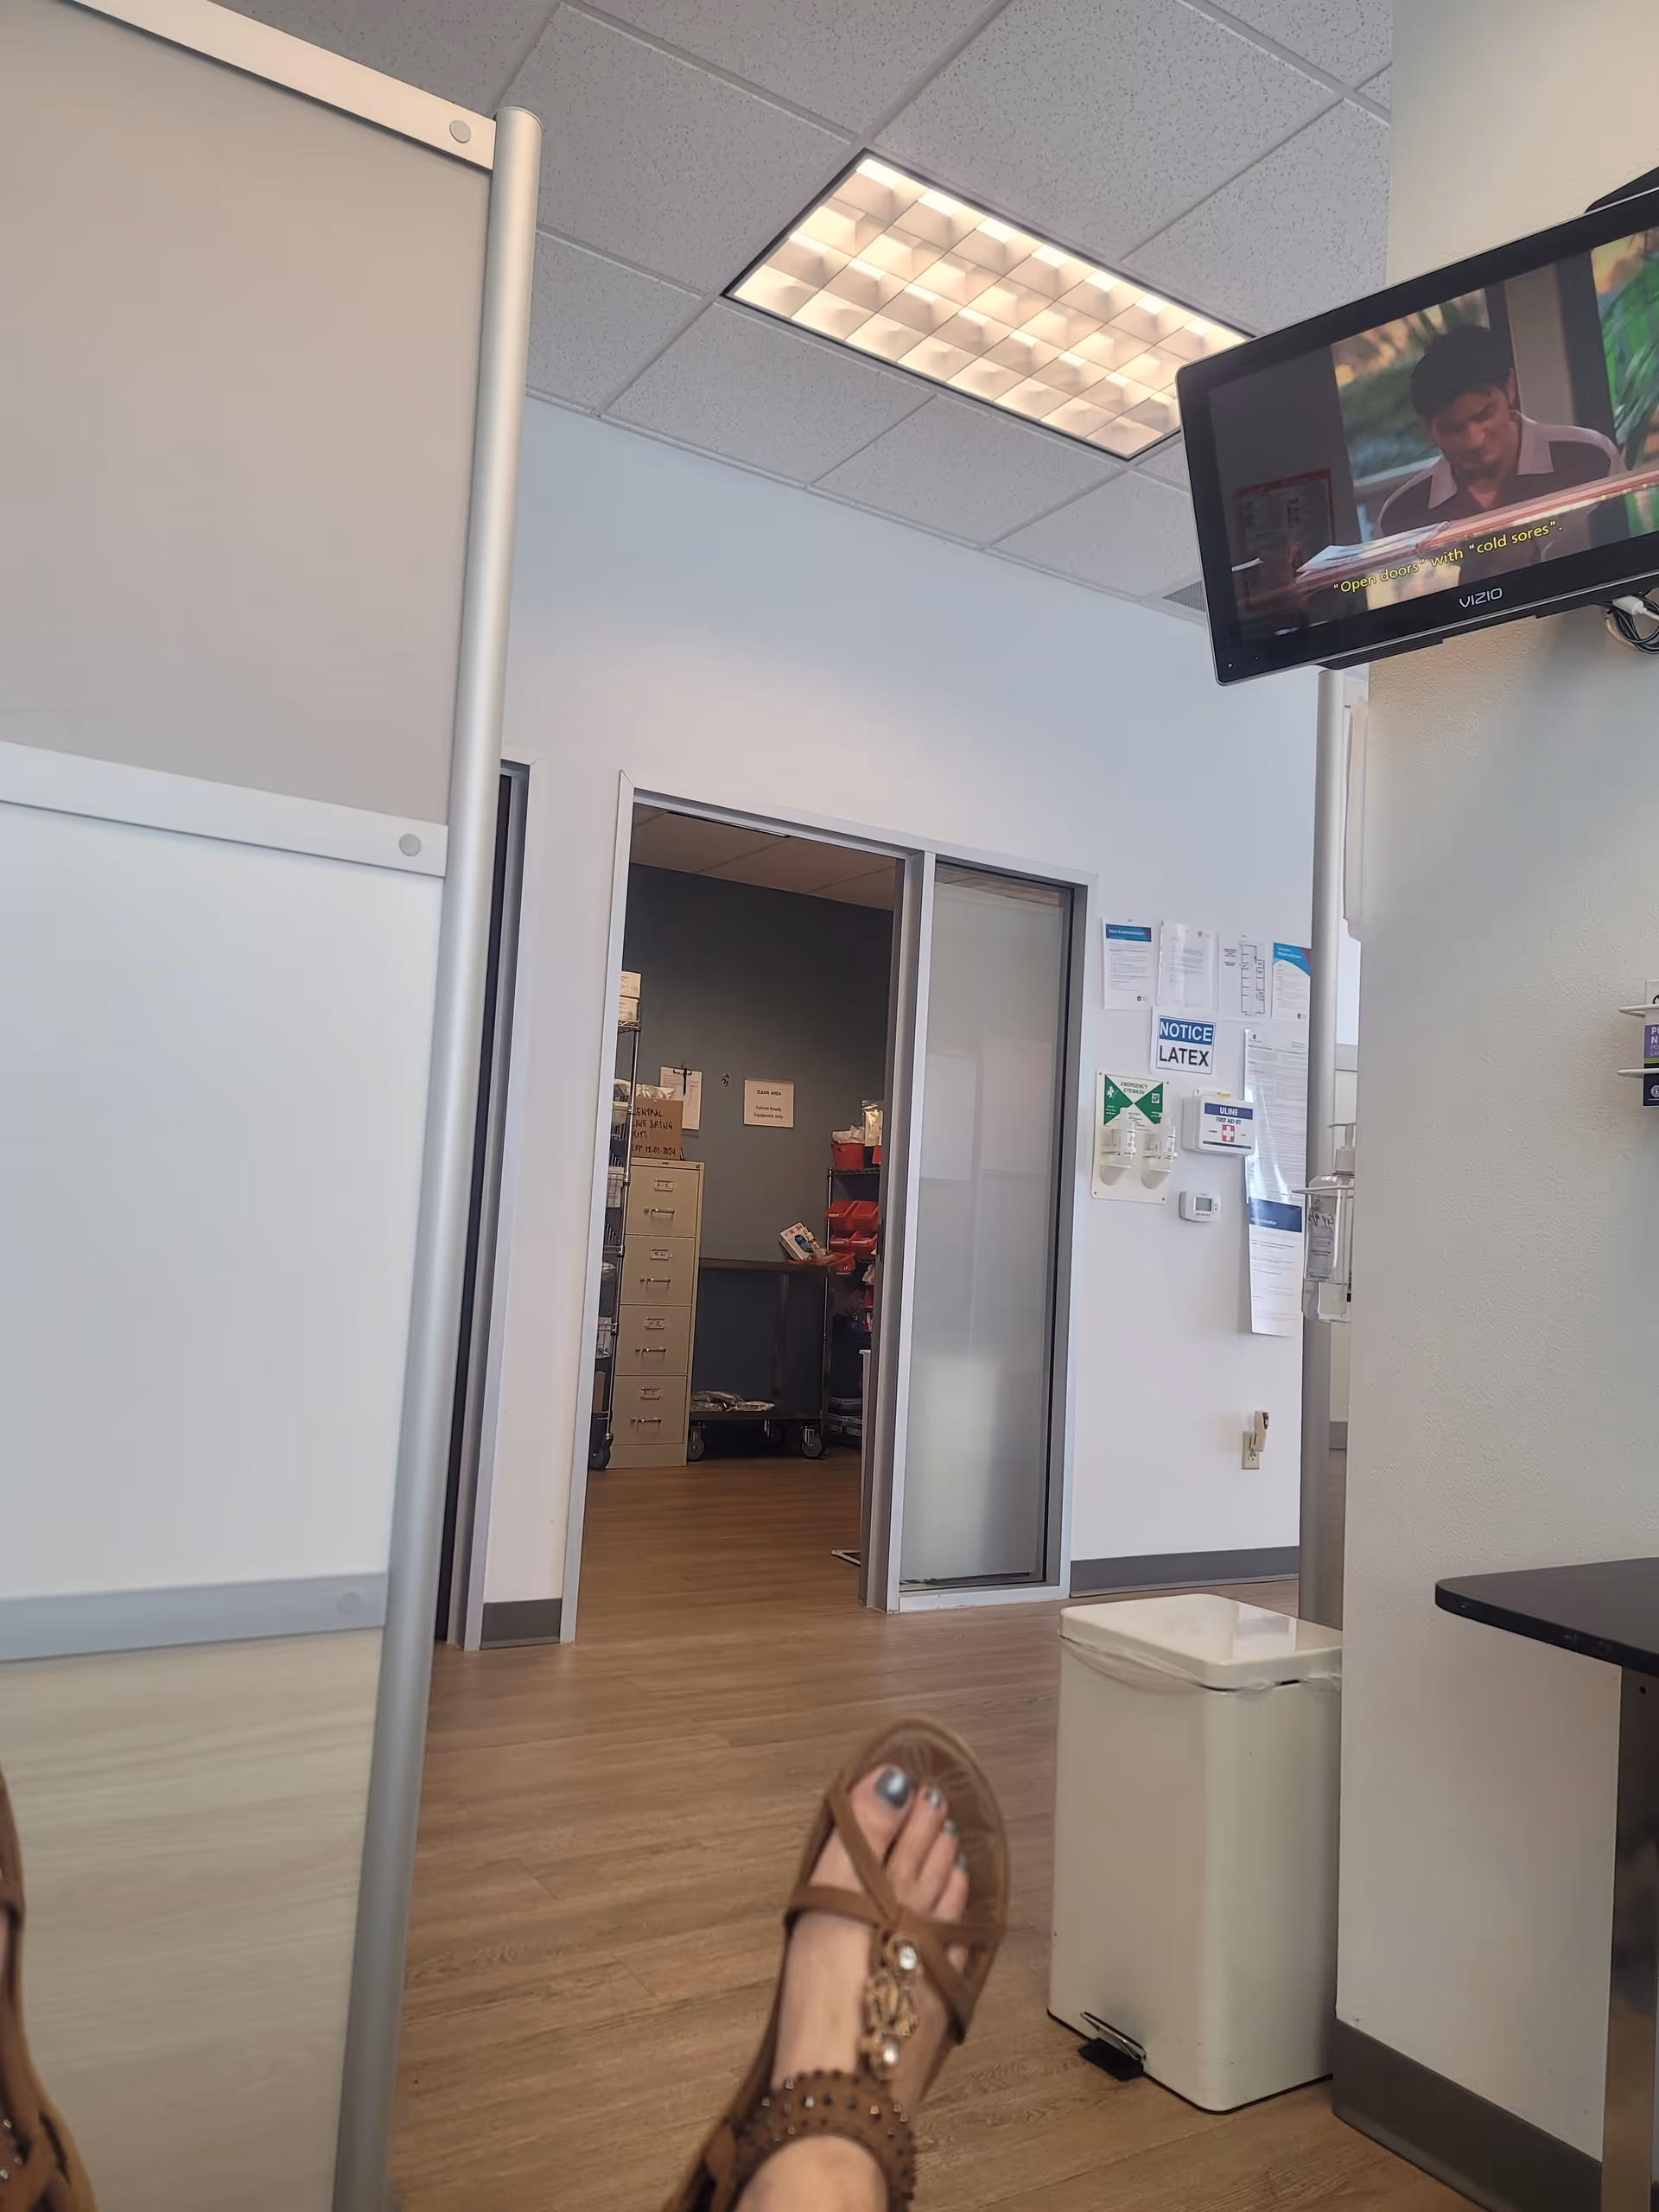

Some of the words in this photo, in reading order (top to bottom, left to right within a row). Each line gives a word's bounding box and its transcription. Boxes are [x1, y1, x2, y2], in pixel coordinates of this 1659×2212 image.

[1333, 575, 1376, 593] "Open
[1380, 558, 1426, 582] doors"
[1430, 549, 1464, 568] with
[1469, 534, 1507, 554] "cold
[1459, 588, 1503, 608] VIZIO
[1160, 1021, 1212, 1042] NOTICE
[1160, 1045, 1210, 1067] LATEX
[1120, 1081, 1147, 1090] EMERGENCY
[1219, 1106, 1238, 1116] ULINE
